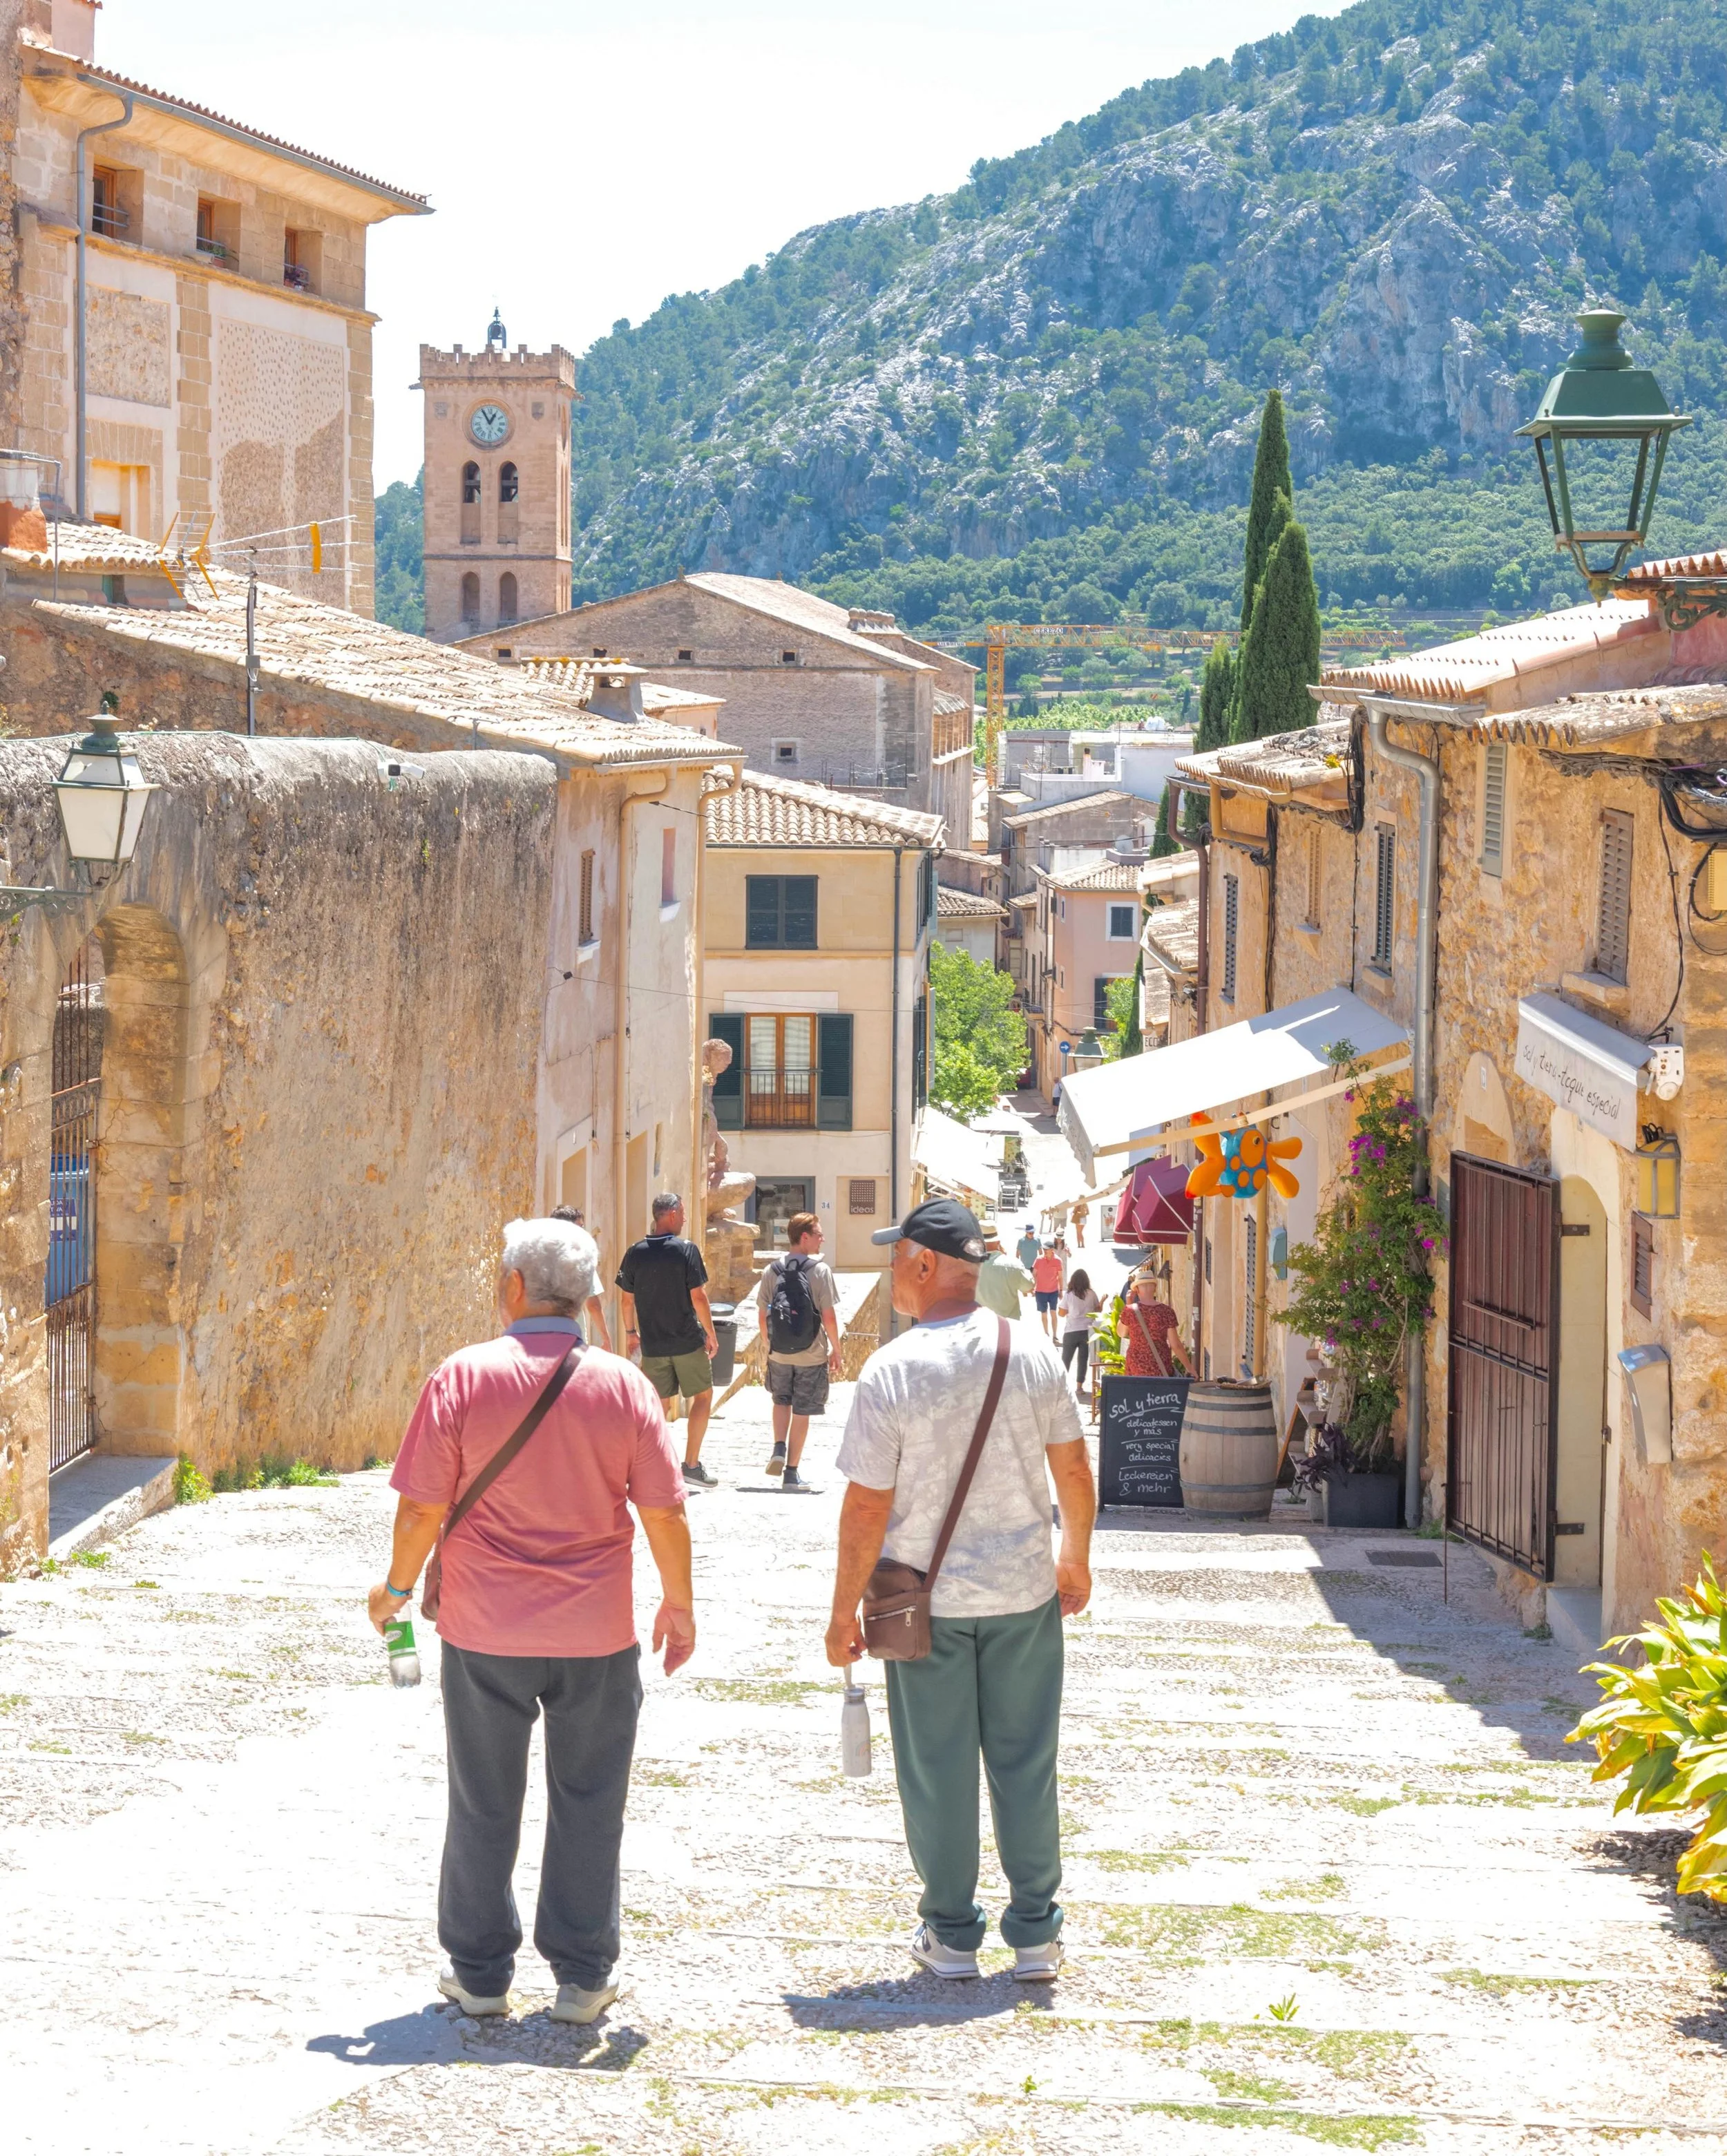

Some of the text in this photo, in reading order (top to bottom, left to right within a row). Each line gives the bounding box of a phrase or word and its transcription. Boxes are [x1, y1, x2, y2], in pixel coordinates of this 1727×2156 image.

[1587, 1092, 1621, 1119] especial
[821, 1201, 830, 1210] 34
[850, 1205, 874, 1214] ideas
[1109, 1393, 1181, 1418] sol y tierra
[1127, 1418, 1177, 1428] delicatessen
[1134, 1429, 1140, 1438] y
[1126, 1442, 1175, 1452] very special
[1129, 1452, 1171, 1462] delicacies
[1119, 1471, 1173, 1481] Leckereien
[1119, 1482, 1171, 1496] & mehr
